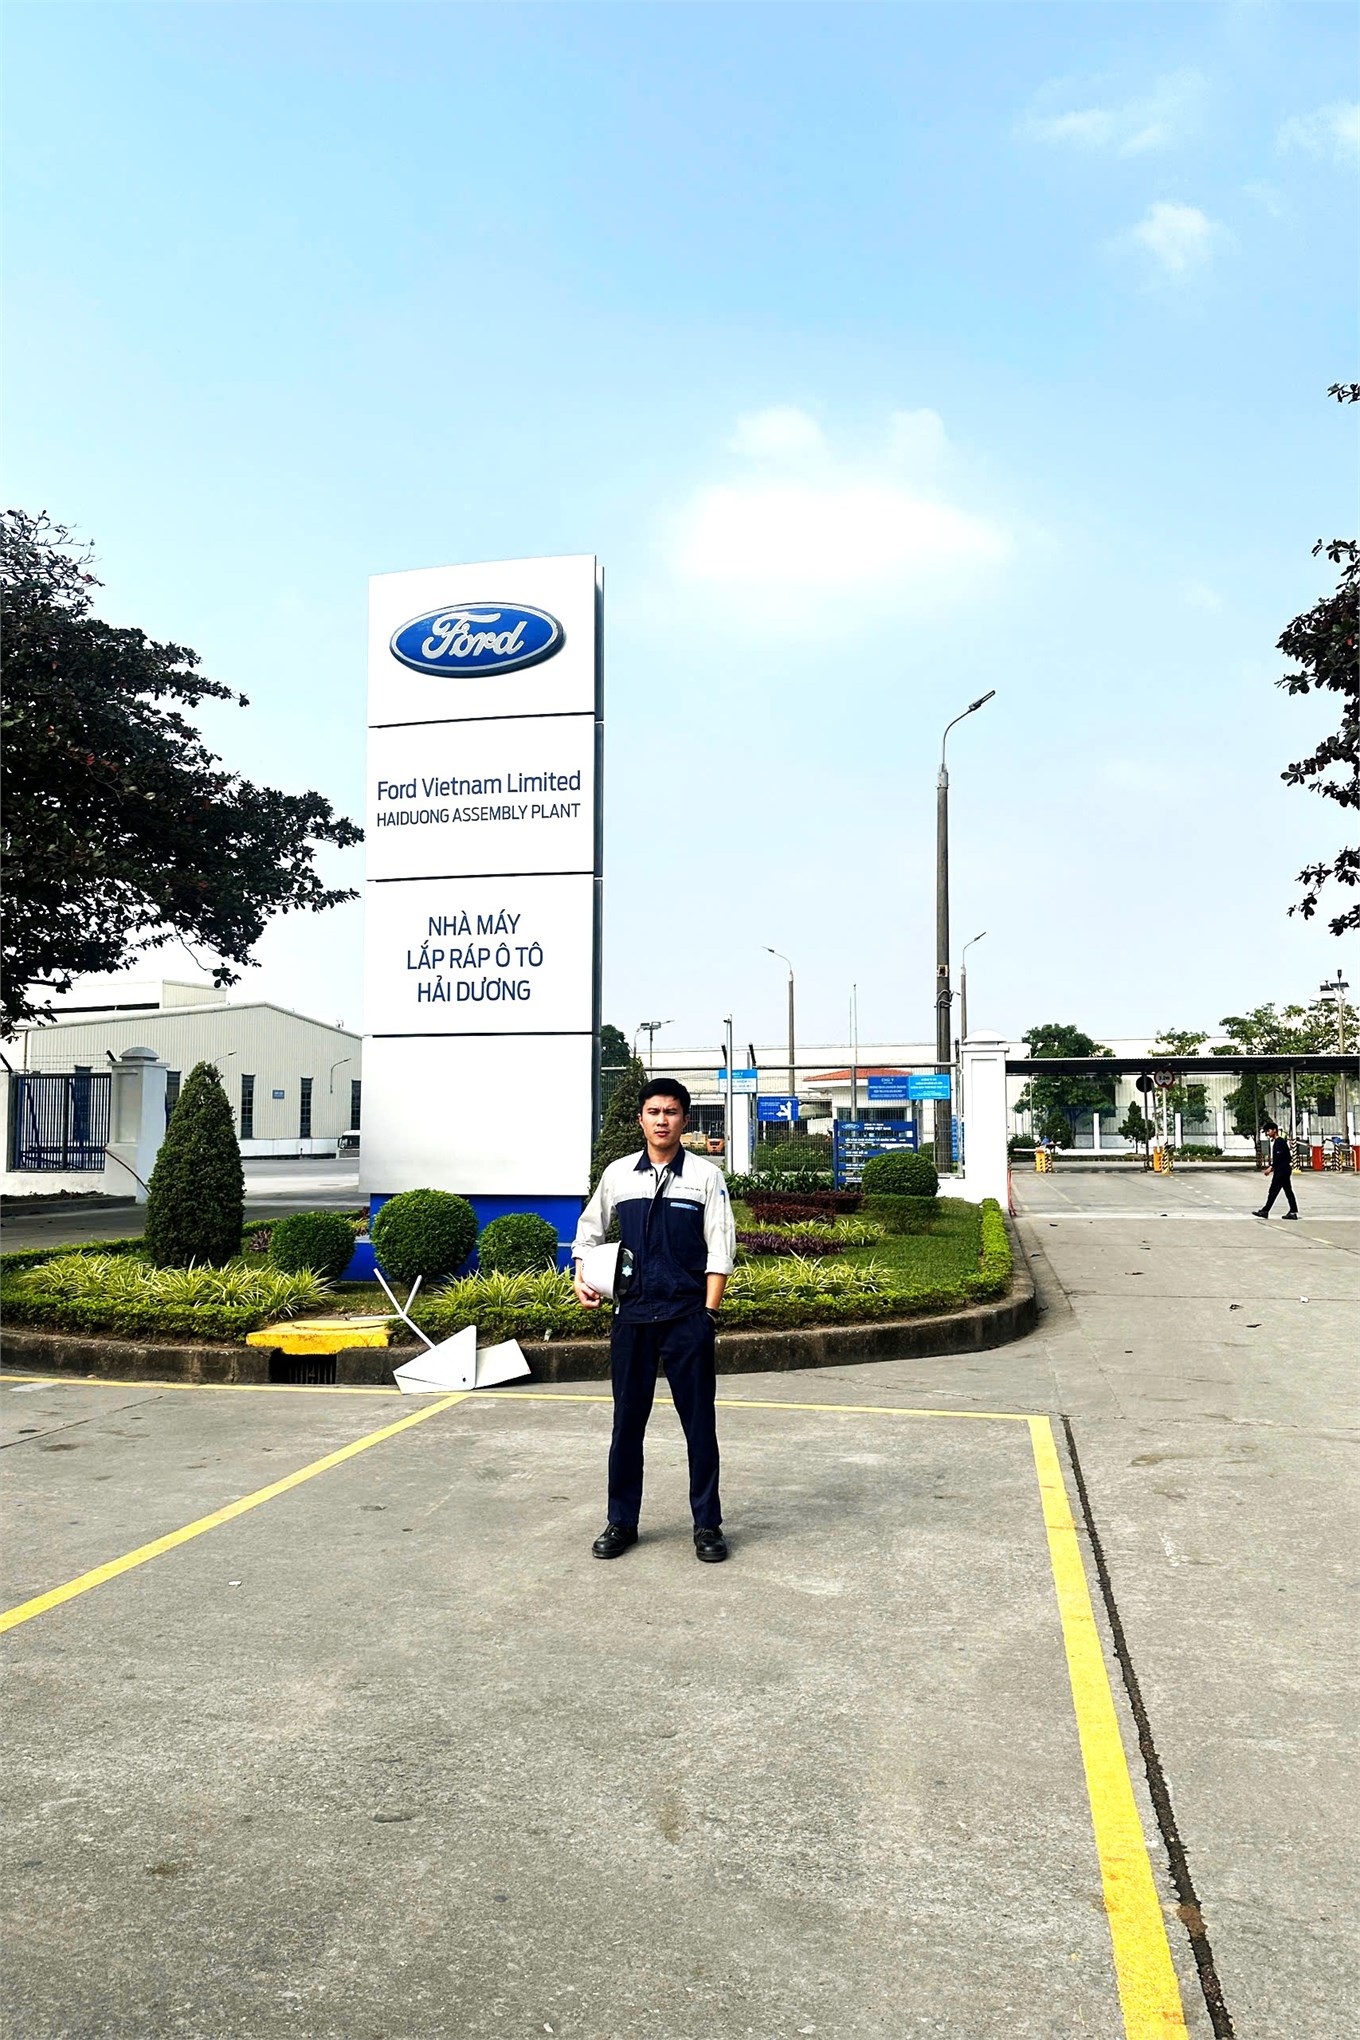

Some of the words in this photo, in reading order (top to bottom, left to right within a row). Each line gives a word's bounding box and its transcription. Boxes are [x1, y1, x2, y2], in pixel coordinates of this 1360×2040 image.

[421, 611, 528, 660] Ford
[377, 778, 418, 801] Ford
[421, 776, 502, 798] Vietnam
[507, 770, 581, 793] Limited
[377, 808, 450, 828] HAIDUONG
[452, 804, 529, 823] ASSEMBLY
[531, 802, 581, 819] PLANT
[428, 910, 473, 937] NHÀ
[477, 908, 521, 936] MÁY
[407, 939, 445, 970] LẮP
[449, 942, 491, 969] RÁP
[495, 942, 511, 968] Ô
[514, 941, 544, 968] TÔ
[417, 974, 451, 1003] HẢI
[456, 976, 531, 1002] DƯƠNG
